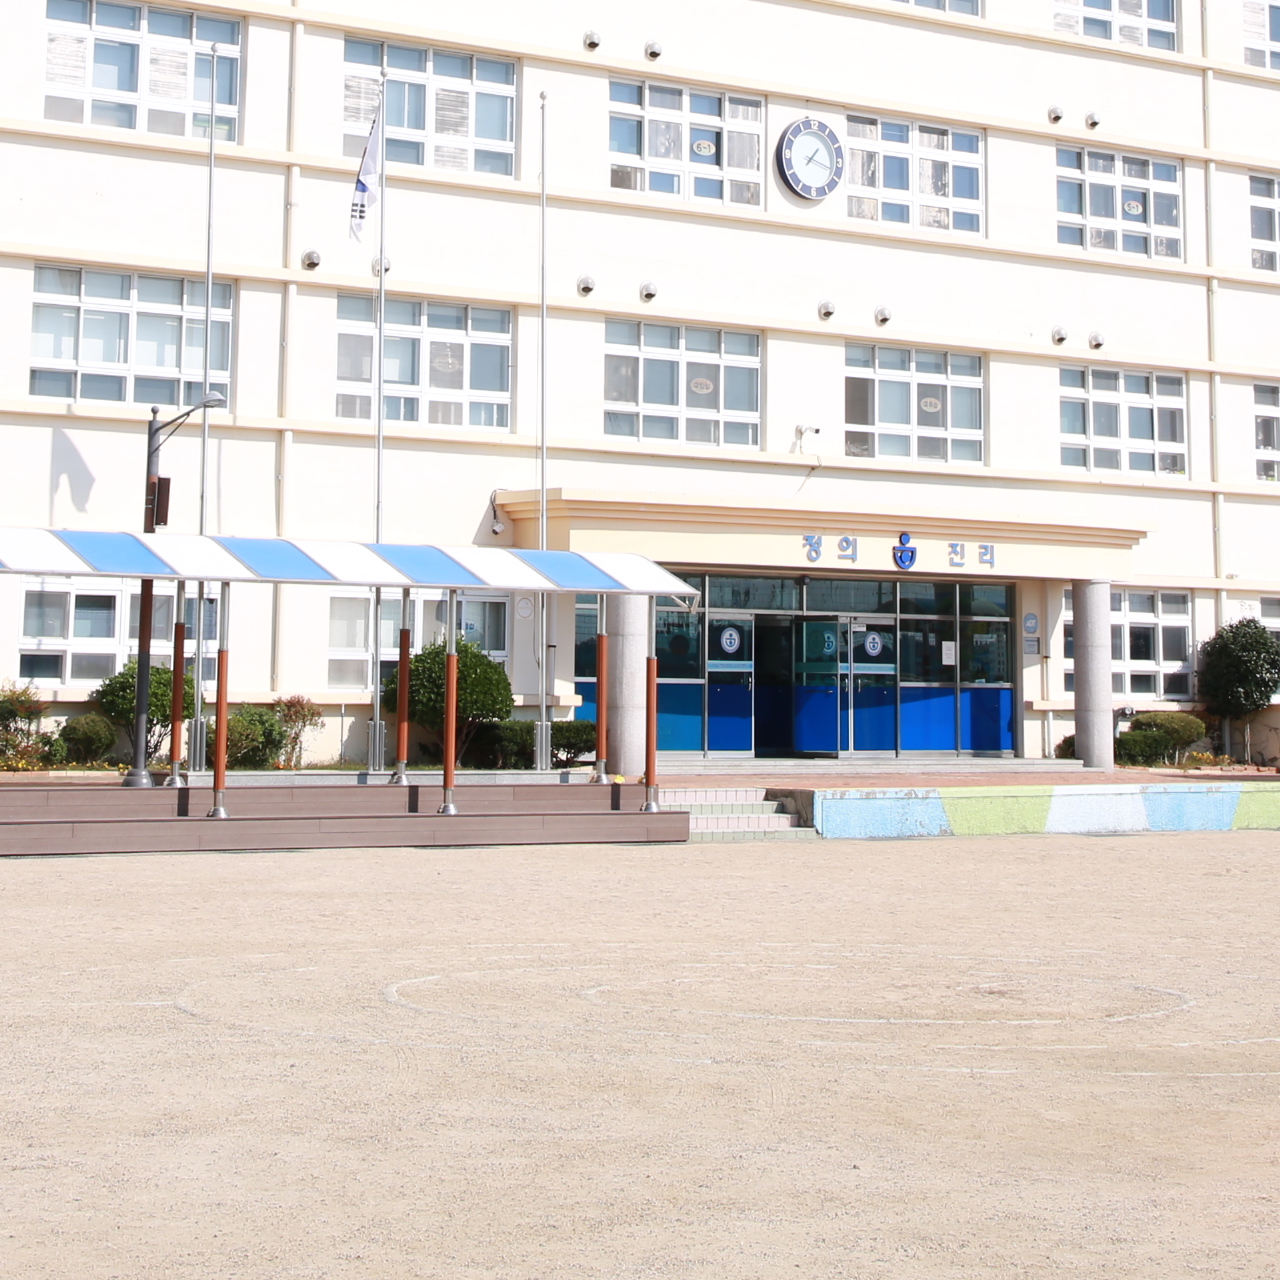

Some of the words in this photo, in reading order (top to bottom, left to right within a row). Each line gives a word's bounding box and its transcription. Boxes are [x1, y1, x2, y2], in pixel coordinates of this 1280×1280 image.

[809, 120, 819, 130] 12
[785, 150, 791, 158] 9
[836, 159, 842, 167] 3
[810, 187, 817, 197] 6
[803, 535, 858, 563] 정의
[948, 542, 995, 569] 진리
